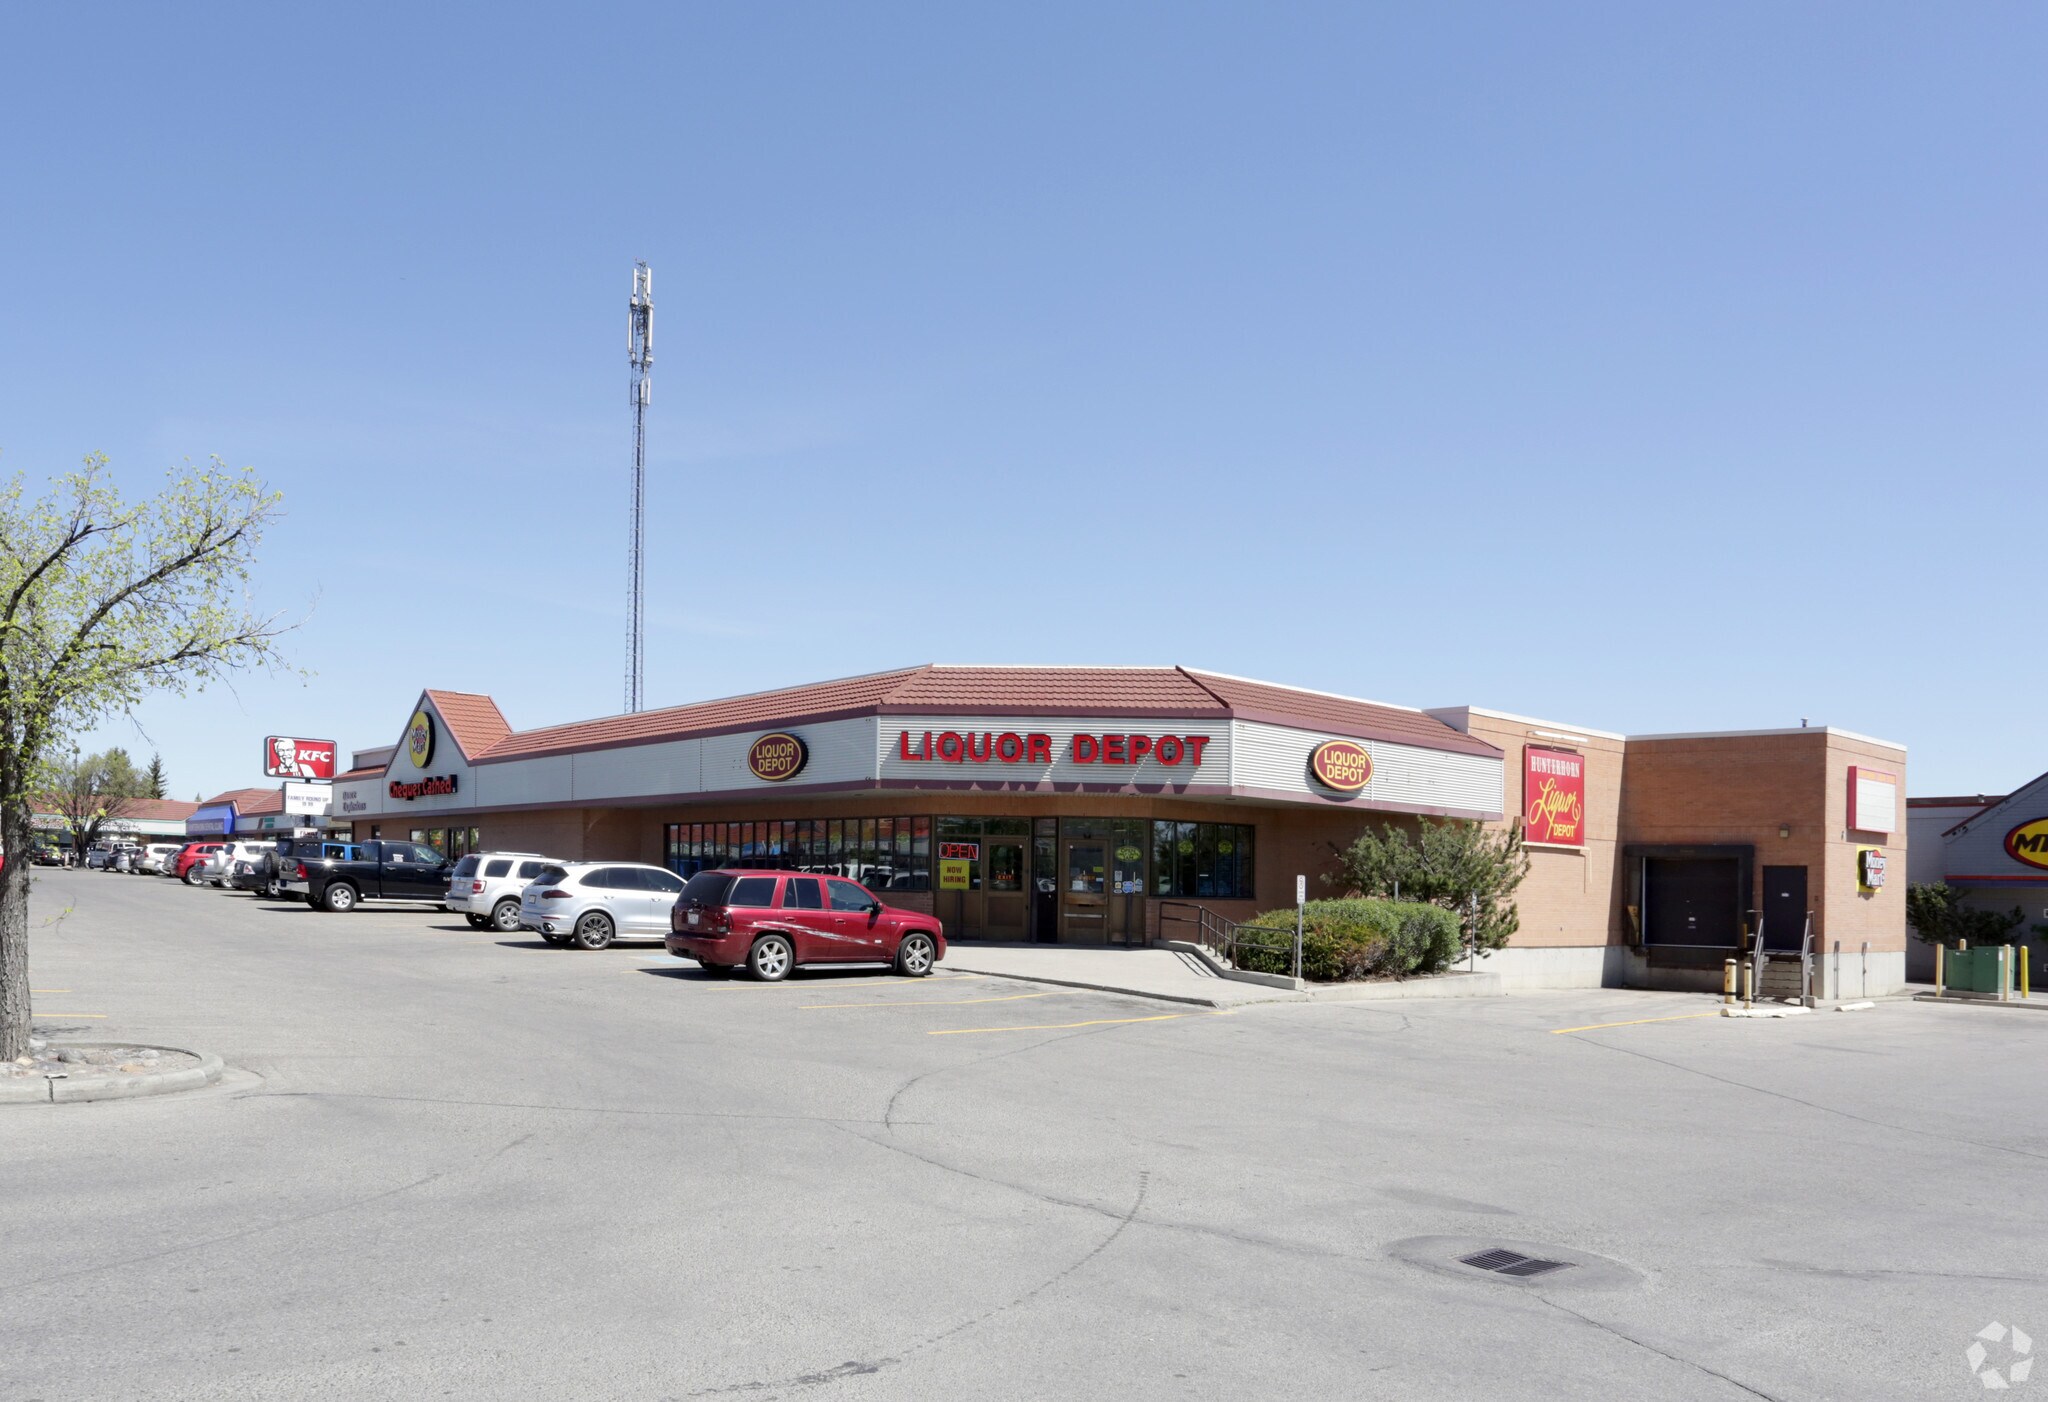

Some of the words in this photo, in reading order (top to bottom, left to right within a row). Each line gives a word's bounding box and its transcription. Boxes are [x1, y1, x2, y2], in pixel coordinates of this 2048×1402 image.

[411, 728, 427, 741] Money
[413, 742, 426, 753] Mart
[756, 743, 794, 758] LIQUOR
[900, 731, 1052, 763] LIQUOR
[1073, 734, 1210, 766] DEPOT
[298, 750, 332, 762] KFC
[1324, 750, 1366, 769] LIQUOR
[758, 757, 792, 772] DEPOT
[1531, 756, 1580, 778] HUNTERHORN
[1326, 765, 1364, 782] DEPOT
[389, 780, 421, 801] Cheques
[1529, 777, 1581, 840] Liquor
[1553, 823, 1576, 837] DEPOT
[940, 844, 977, 858] OPEN
[1866, 851, 1886, 868] Money
[947, 866, 963, 874] NOW
[1867, 869, 1885, 886] Mart
